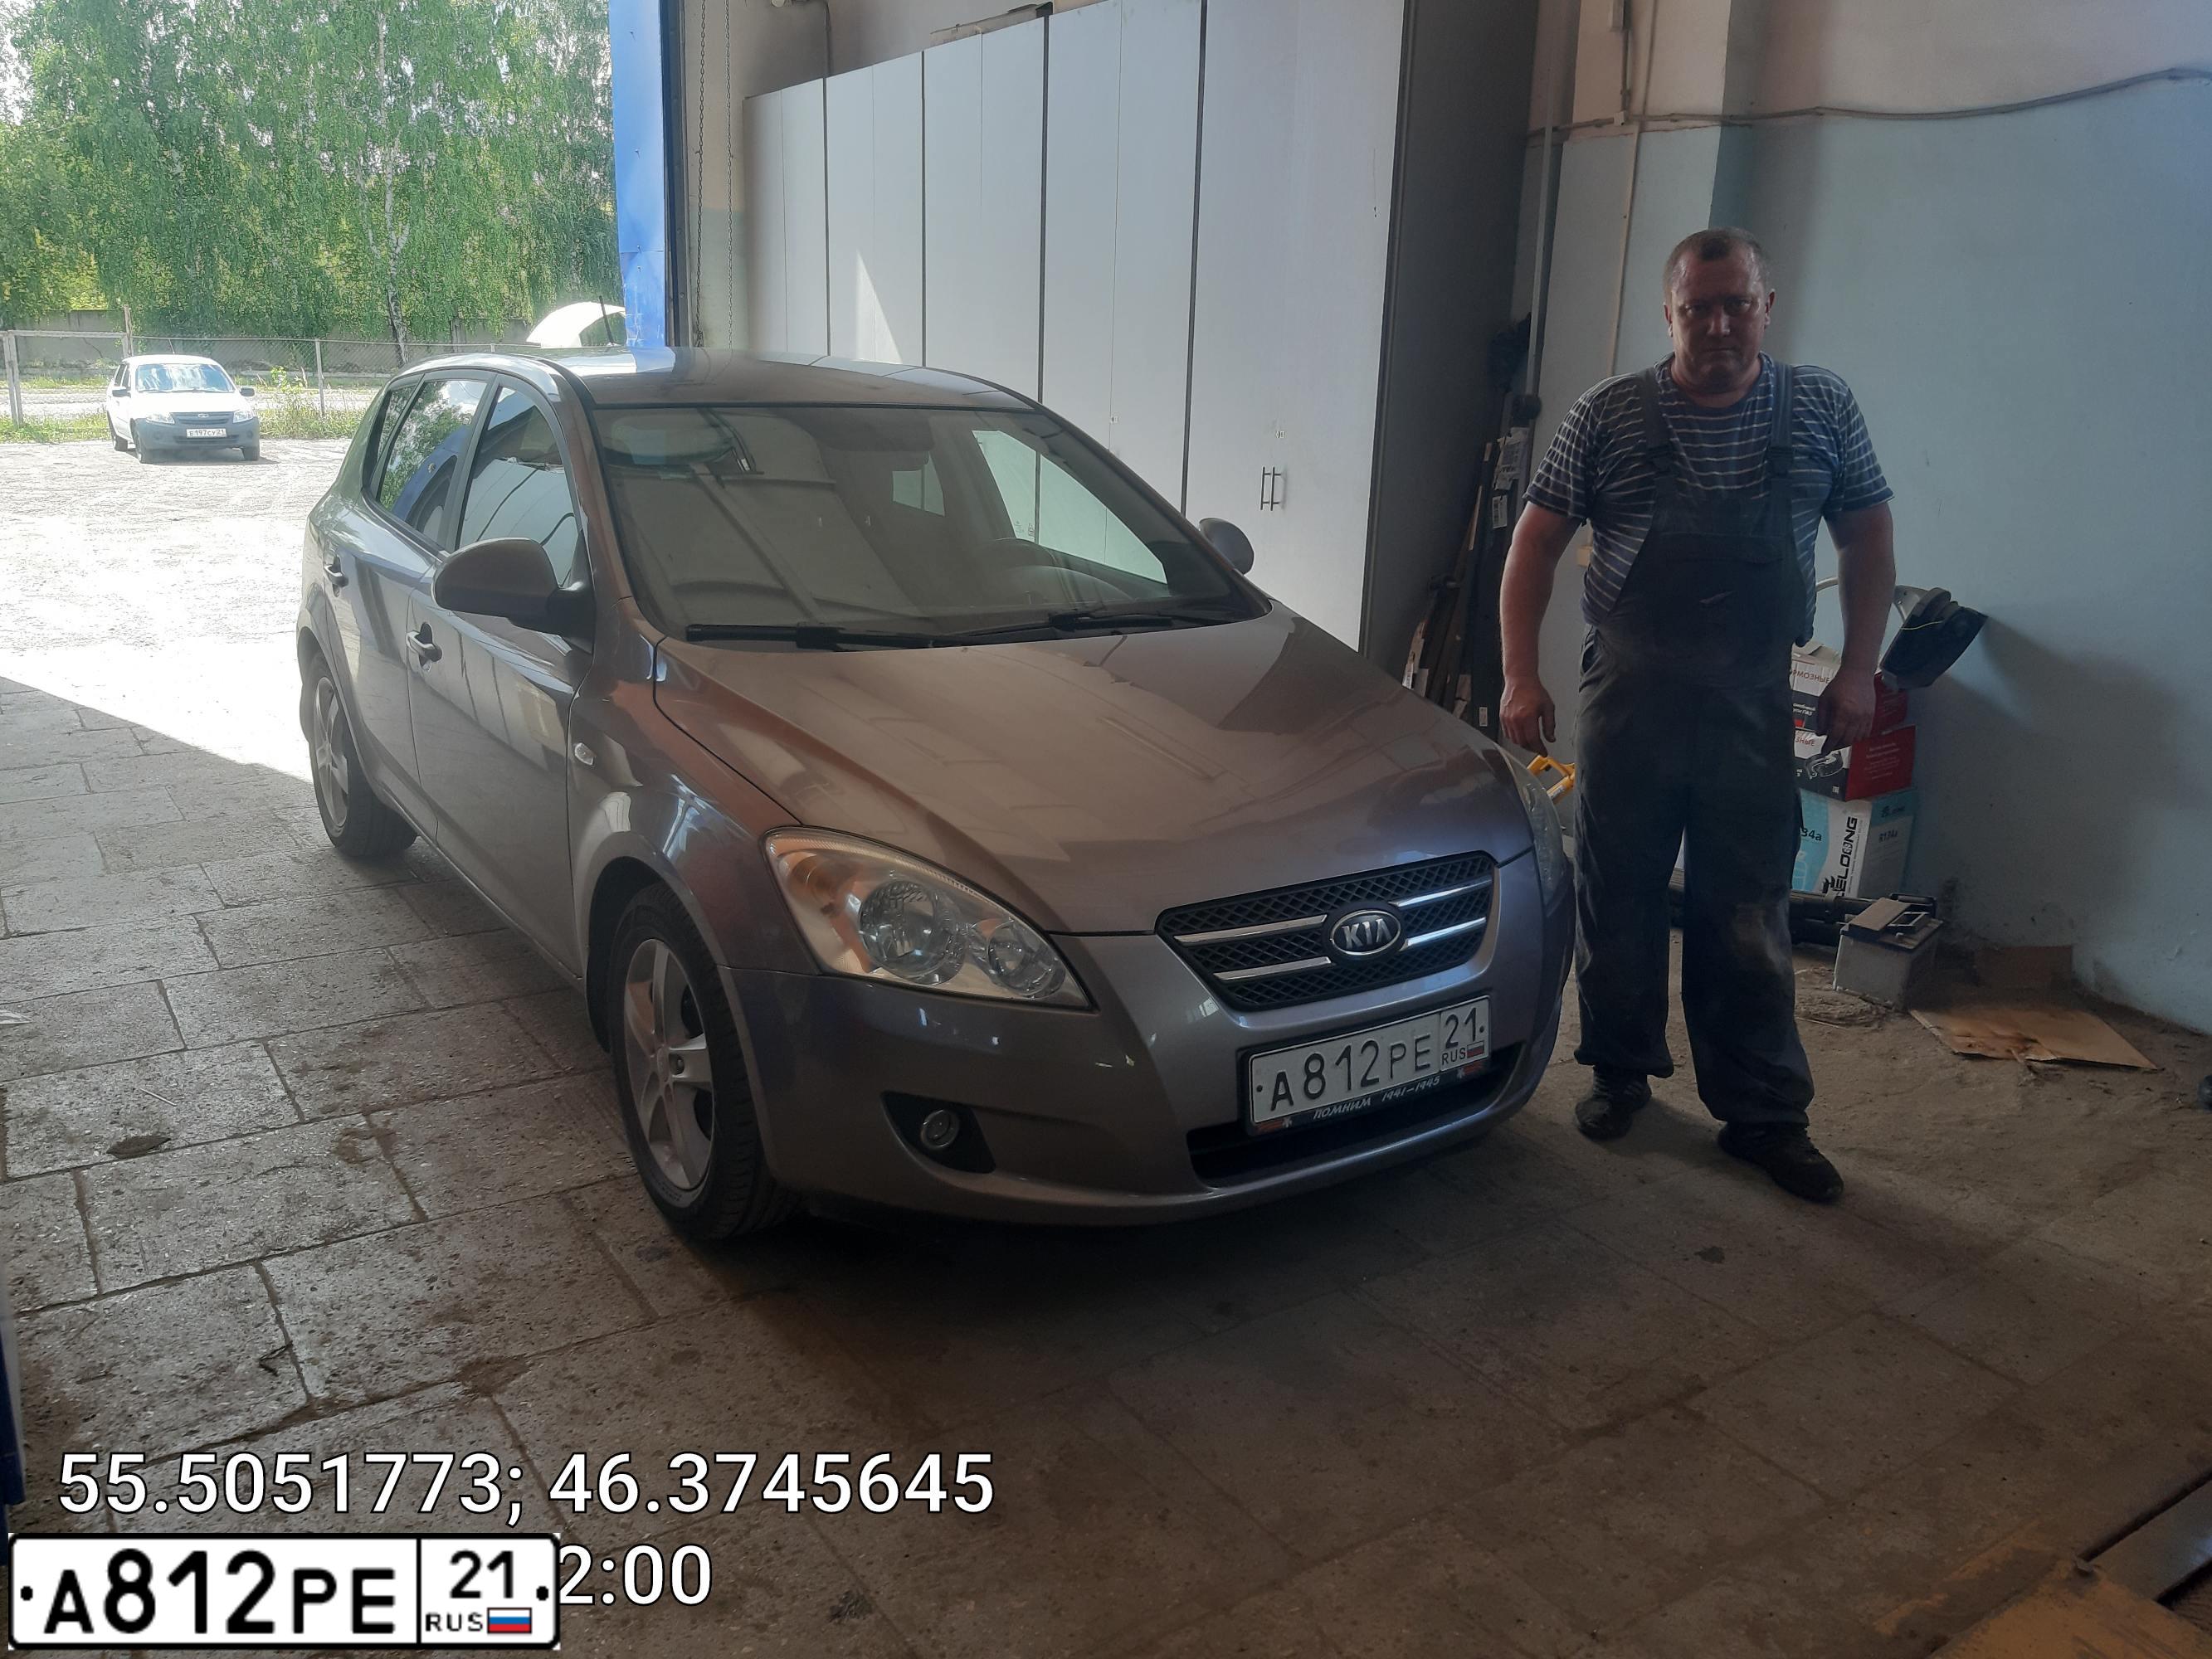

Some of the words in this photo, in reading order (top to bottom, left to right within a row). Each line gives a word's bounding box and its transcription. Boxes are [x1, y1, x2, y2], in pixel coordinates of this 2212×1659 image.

[1792, 669, 1830, 684] РМОЗНЫЕ
[1795, 736, 1815, 747] ЗНЫЕ
[1800, 828, 1822, 841] 34a
[1833, 816, 1858, 896] ELOONG
[1341, 918, 1393, 949] KIA
[1270, 1034, 1431, 1112] А812РЕ
[1445, 1007, 1477, 1049] 21
[1441, 1047, 1466, 1066] RUS
[1313, 1097, 1372, 1120] ПОМНИМ
